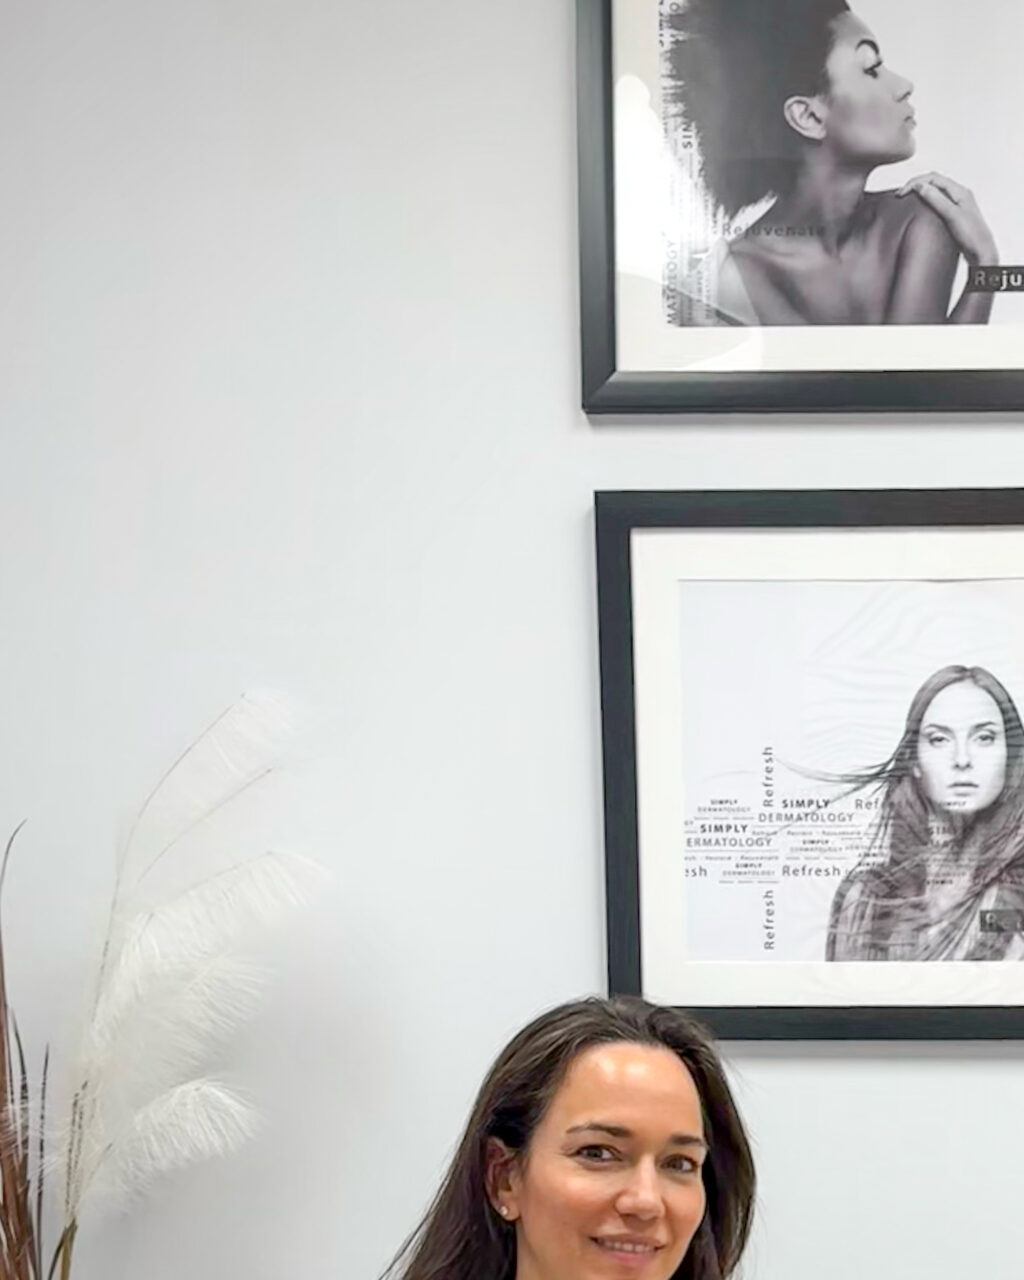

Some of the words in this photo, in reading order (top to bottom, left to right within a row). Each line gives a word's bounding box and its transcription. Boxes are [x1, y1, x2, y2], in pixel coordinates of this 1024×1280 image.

[761, 746, 774, 808] Refresh
[781, 799, 831, 809] SIMPLY
[758, 812, 855, 822] DERMATOLOGY
[699, 823, 749, 834] SIMPLY
[686, 837, 773, 848] ERMATOLOGY
[782, 865, 841, 877] Refresh
[763, 890, 775, 950] Refresh
